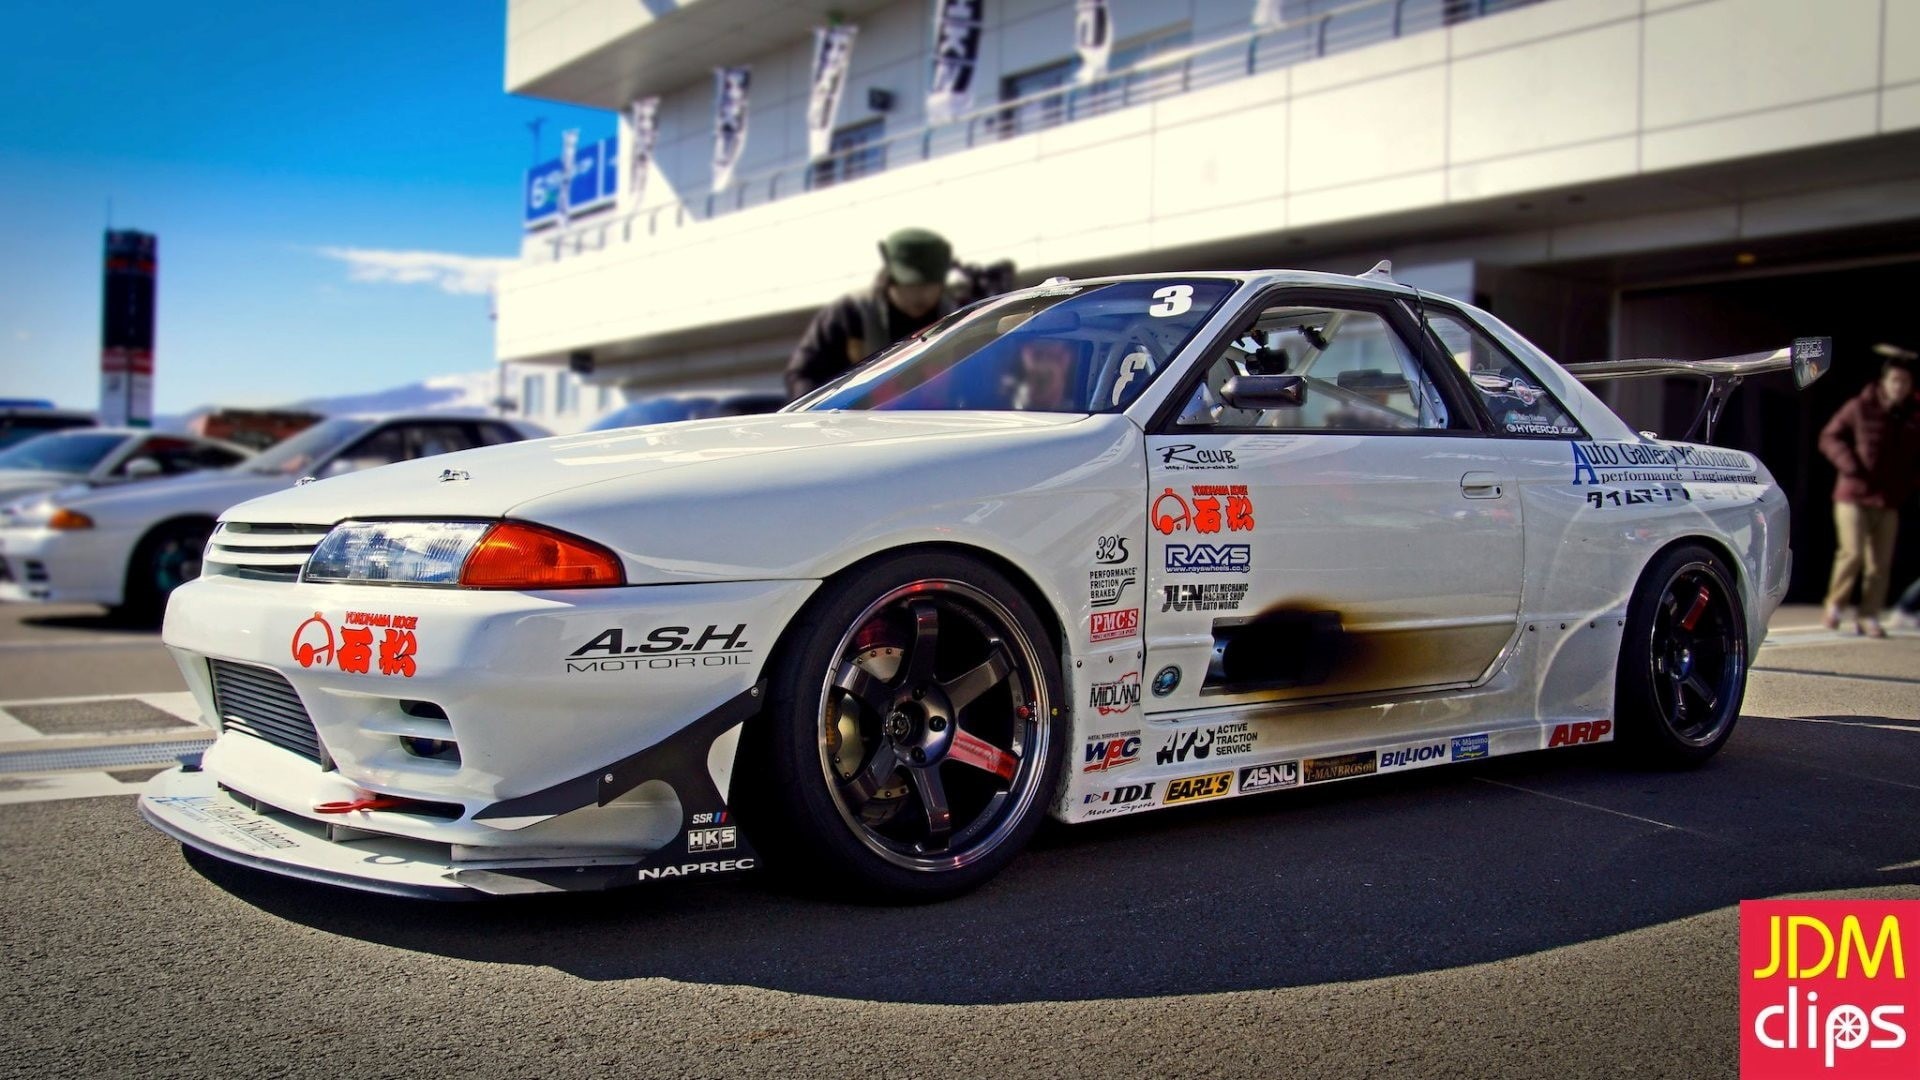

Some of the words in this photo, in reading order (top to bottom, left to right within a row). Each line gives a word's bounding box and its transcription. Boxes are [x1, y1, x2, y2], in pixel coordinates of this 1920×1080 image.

[1149, 284, 1194, 317] 3
[1197, 449, 1236, 463] CLUB
[1571, 440, 1619, 485] Auto
[1618, 443, 1679, 471] Gallery
[1673, 446, 1750, 468] Yokohama
[1601, 471, 1683, 484] performance
[1693, 471, 1758, 484] Engineering
[1167, 546, 1250, 567] RAYS
[1090, 567, 1136, 579] PERFORMANCE
[1090, 579, 1119, 589] FRICTION
[1204, 584, 1219, 593] AUTO
[1220, 583, 1249, 592] MECHANIC
[1090, 589, 1116, 599] BRAKES
[1162, 585, 1204, 612] JUN
[1230, 591, 1245, 600] SHOP
[1202, 601, 1218, 611] AUTO
[1218, 600, 1239, 610] WORKS
[569, 623, 748, 657] A.S.H.
[567, 658, 696, 673] MOTOR
[702, 656, 751, 666] OIL
[1089, 684, 1141, 707] MIDLAND
[1217, 723, 1248, 734] ACTIVE
[1548, 719, 1612, 747] ARP
[1217, 732, 1258, 745] TRACTION
[1216, 744, 1252, 756] SERVICE
[1380, 744, 1446, 767] BILLION
[1242, 764, 1297, 788] ASNU
[1110, 782, 1156, 805] IDI
[1166, 774, 1230, 800] EARL'S
[692, 813, 713, 824] SSR
[1083, 808, 1117, 818] Motor
[1118, 802, 1156, 812] Sports
[688, 828, 736, 850] HKS
[638, 858, 754, 880] NAPREC
